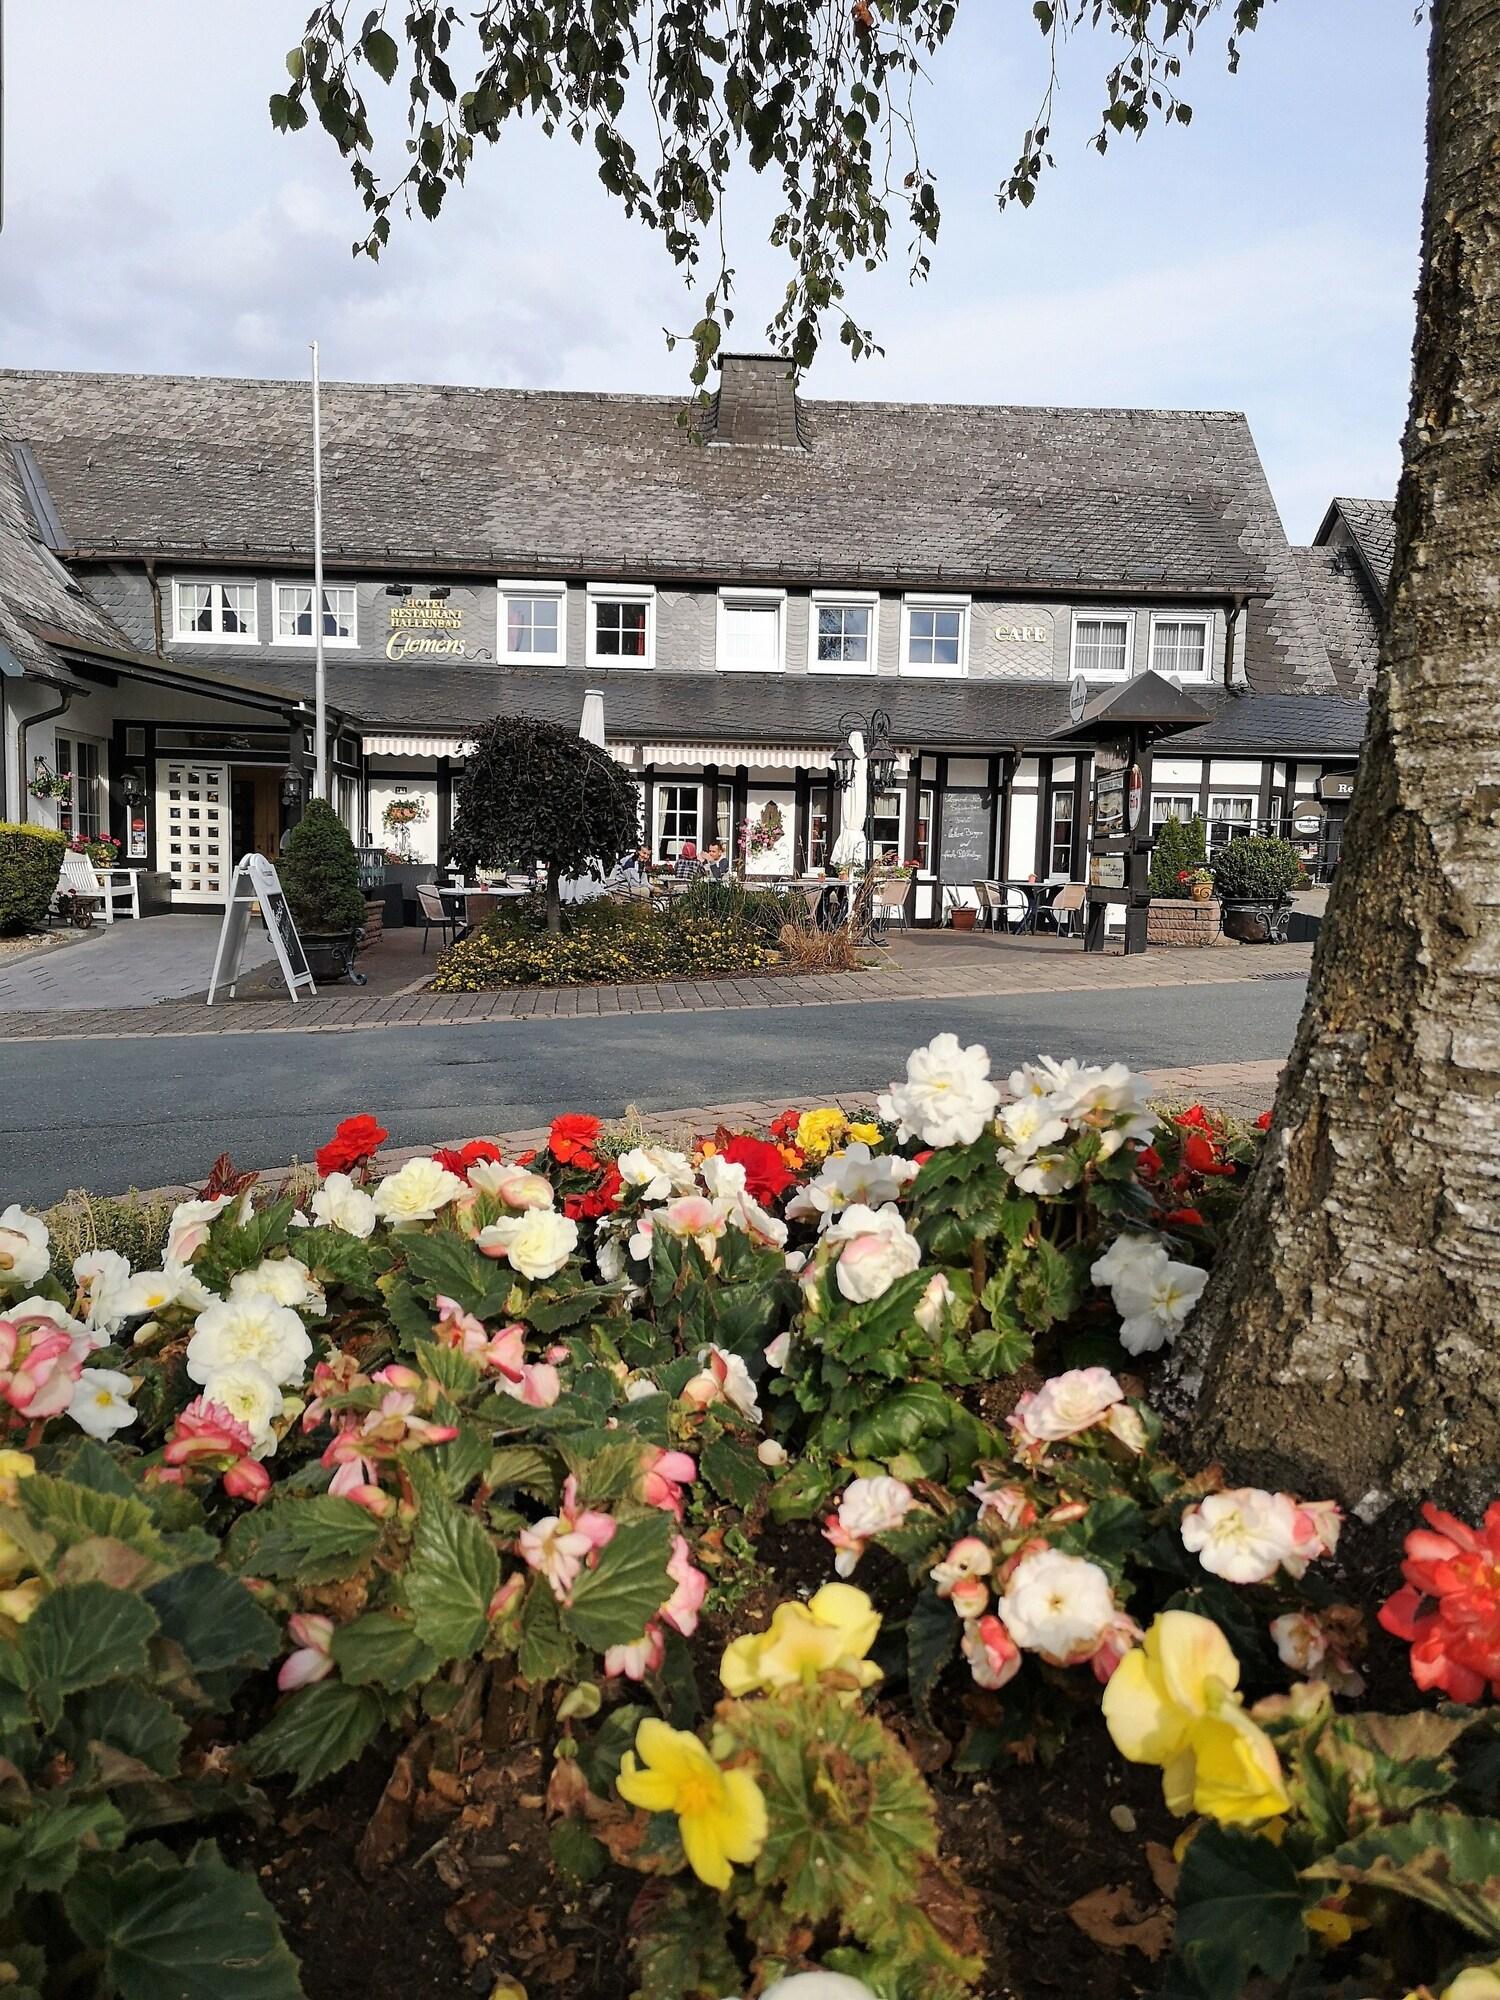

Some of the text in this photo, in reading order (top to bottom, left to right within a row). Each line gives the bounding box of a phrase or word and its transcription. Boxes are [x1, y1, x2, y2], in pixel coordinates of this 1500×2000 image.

[406, 599, 447, 609] HOTEL
[390, 608, 463, 619] RESTAURANT
[390, 618, 461, 629] HALLENBAD
[995, 625, 1047, 642] CAFE
[385, 630, 466, 661] Clemens
